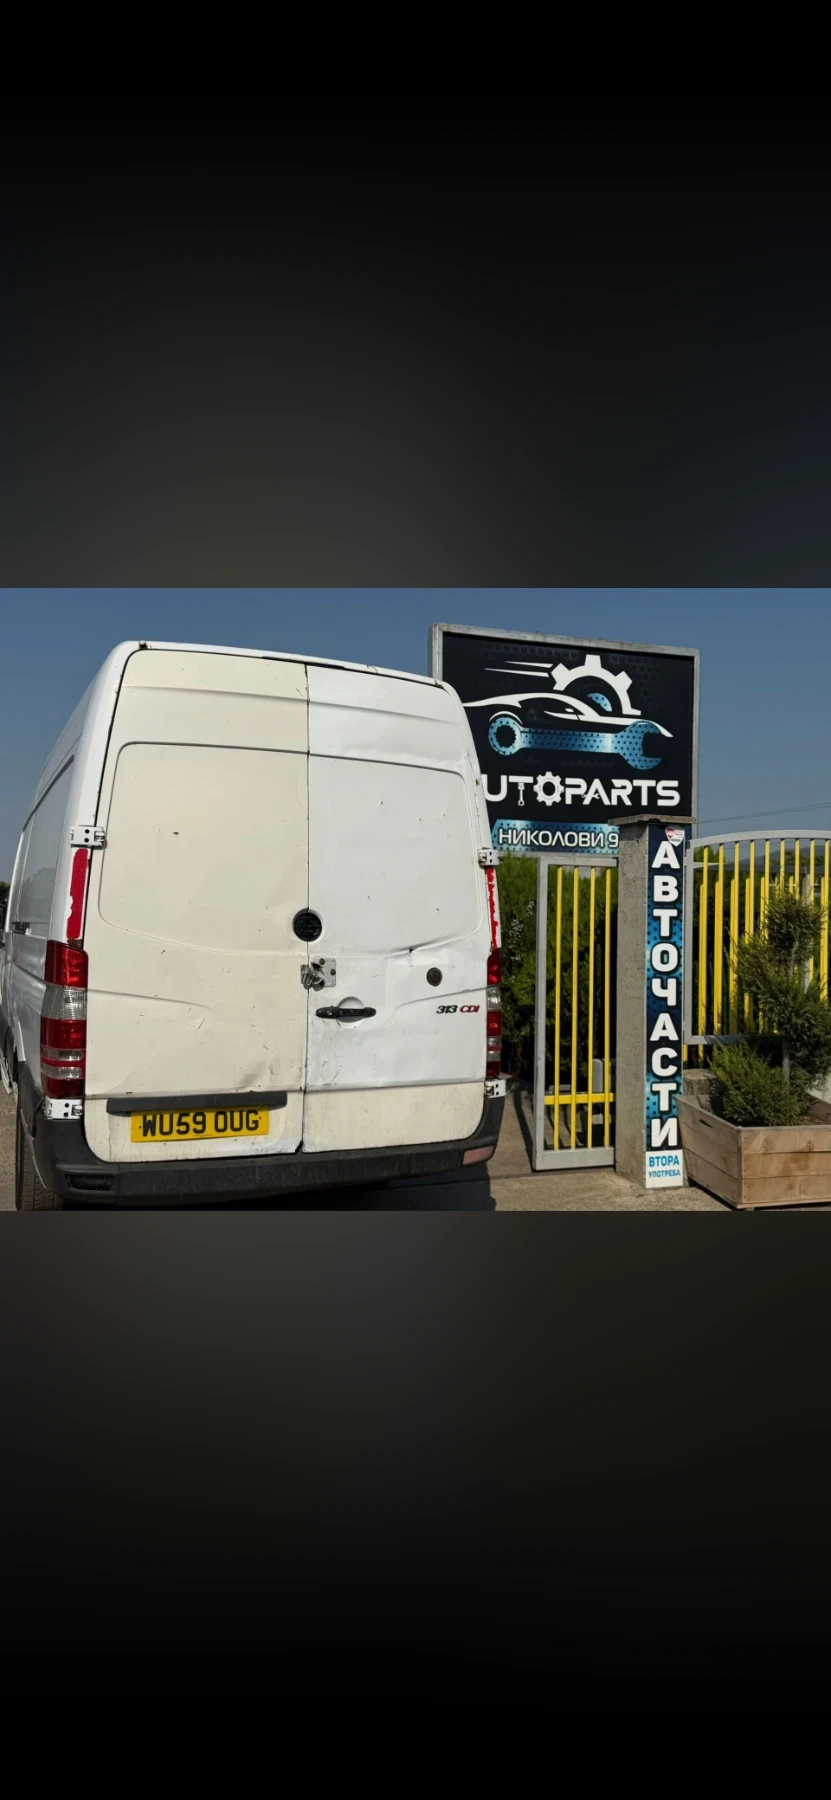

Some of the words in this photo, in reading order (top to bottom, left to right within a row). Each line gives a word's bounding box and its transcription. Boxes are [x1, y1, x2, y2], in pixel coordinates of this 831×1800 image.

[481, 771, 680, 806] UTOPARTS
[499, 828, 604, 848] НИКОЛОВИ
[650, 840, 680, 1147] АВТОЧАСТИ
[436, 1005, 458, 1014] 313
[459, 1005, 480, 1013] CDI
[142, 1112, 206, 1137] WU59
[214, 1109, 259, 1133] OUG
[649, 1155, 680, 1167] ВТОРА
[648, 1169, 681, 1178] УПОТРЕБА
